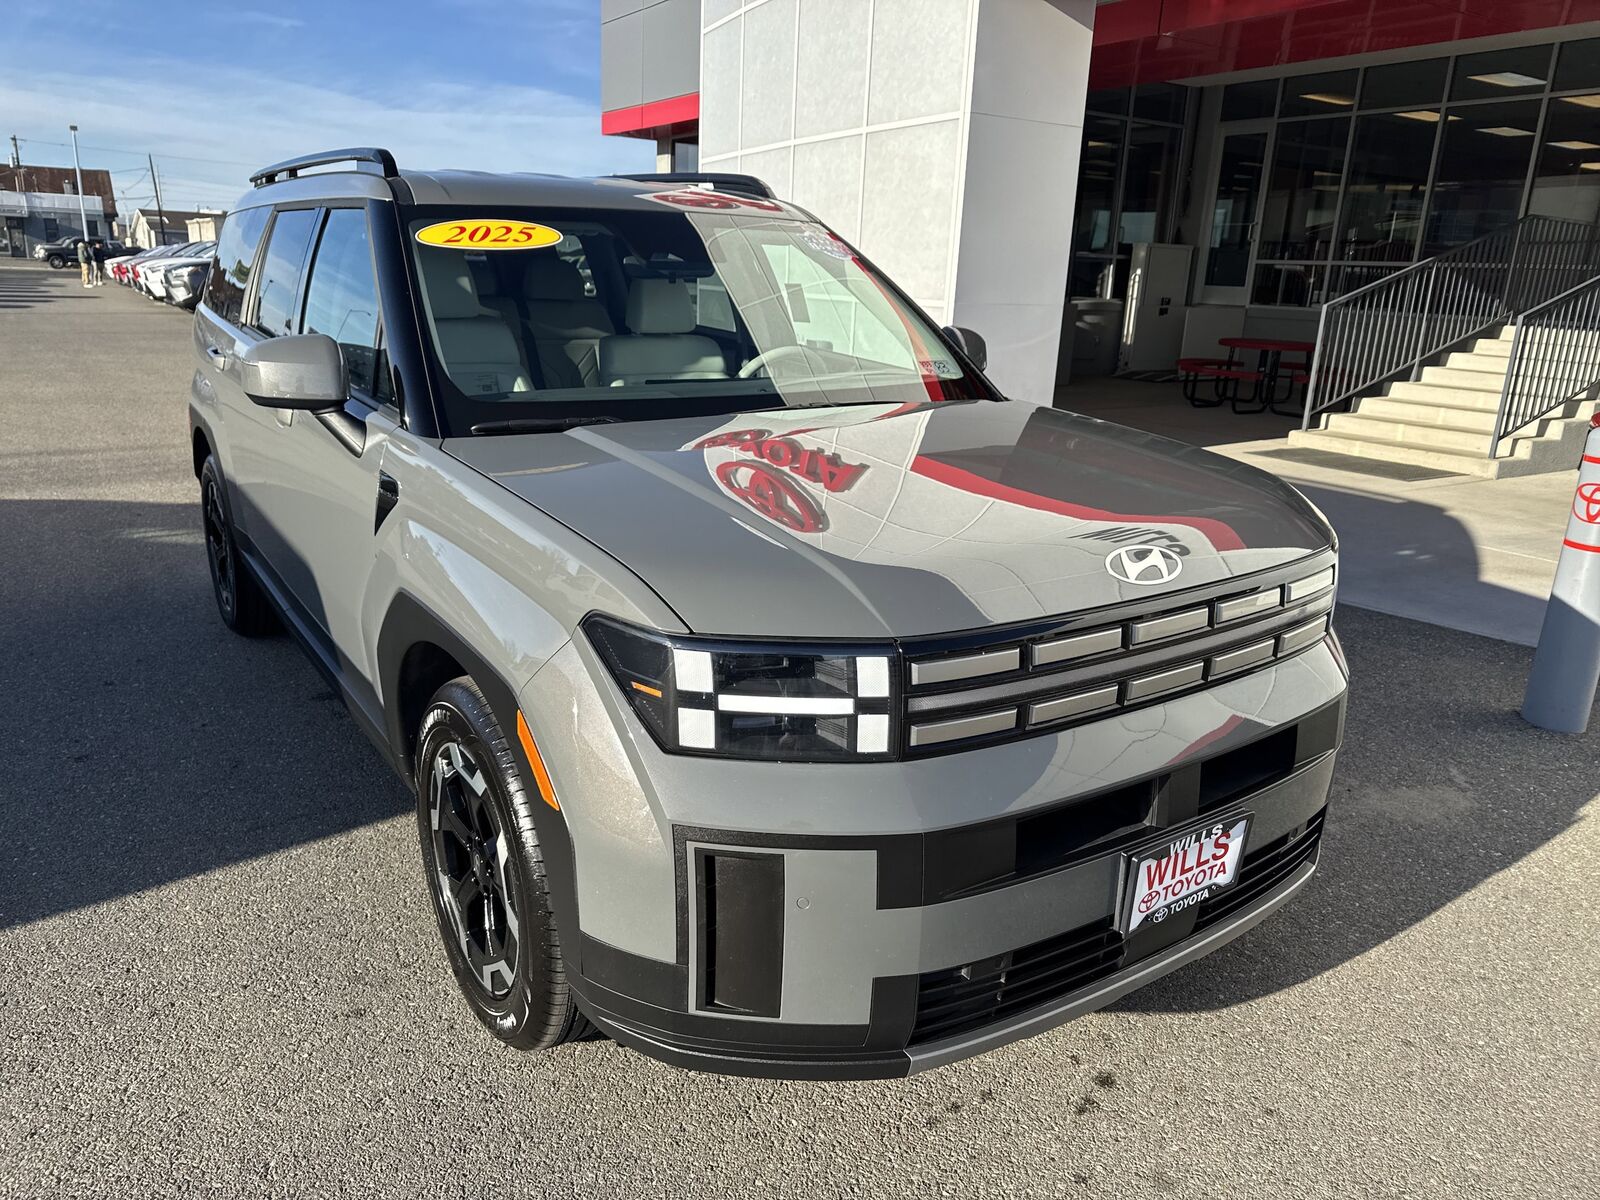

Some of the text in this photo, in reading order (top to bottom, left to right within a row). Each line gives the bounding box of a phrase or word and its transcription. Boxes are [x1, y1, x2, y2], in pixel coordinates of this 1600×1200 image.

[443, 225, 537, 243] 2025
[1169, 823, 1224, 857] WILLS
[1146, 831, 1232, 891] WILLS
[1162, 861, 1227, 902] TOYOTA
[1169, 888, 1210, 915] TOYOTA
